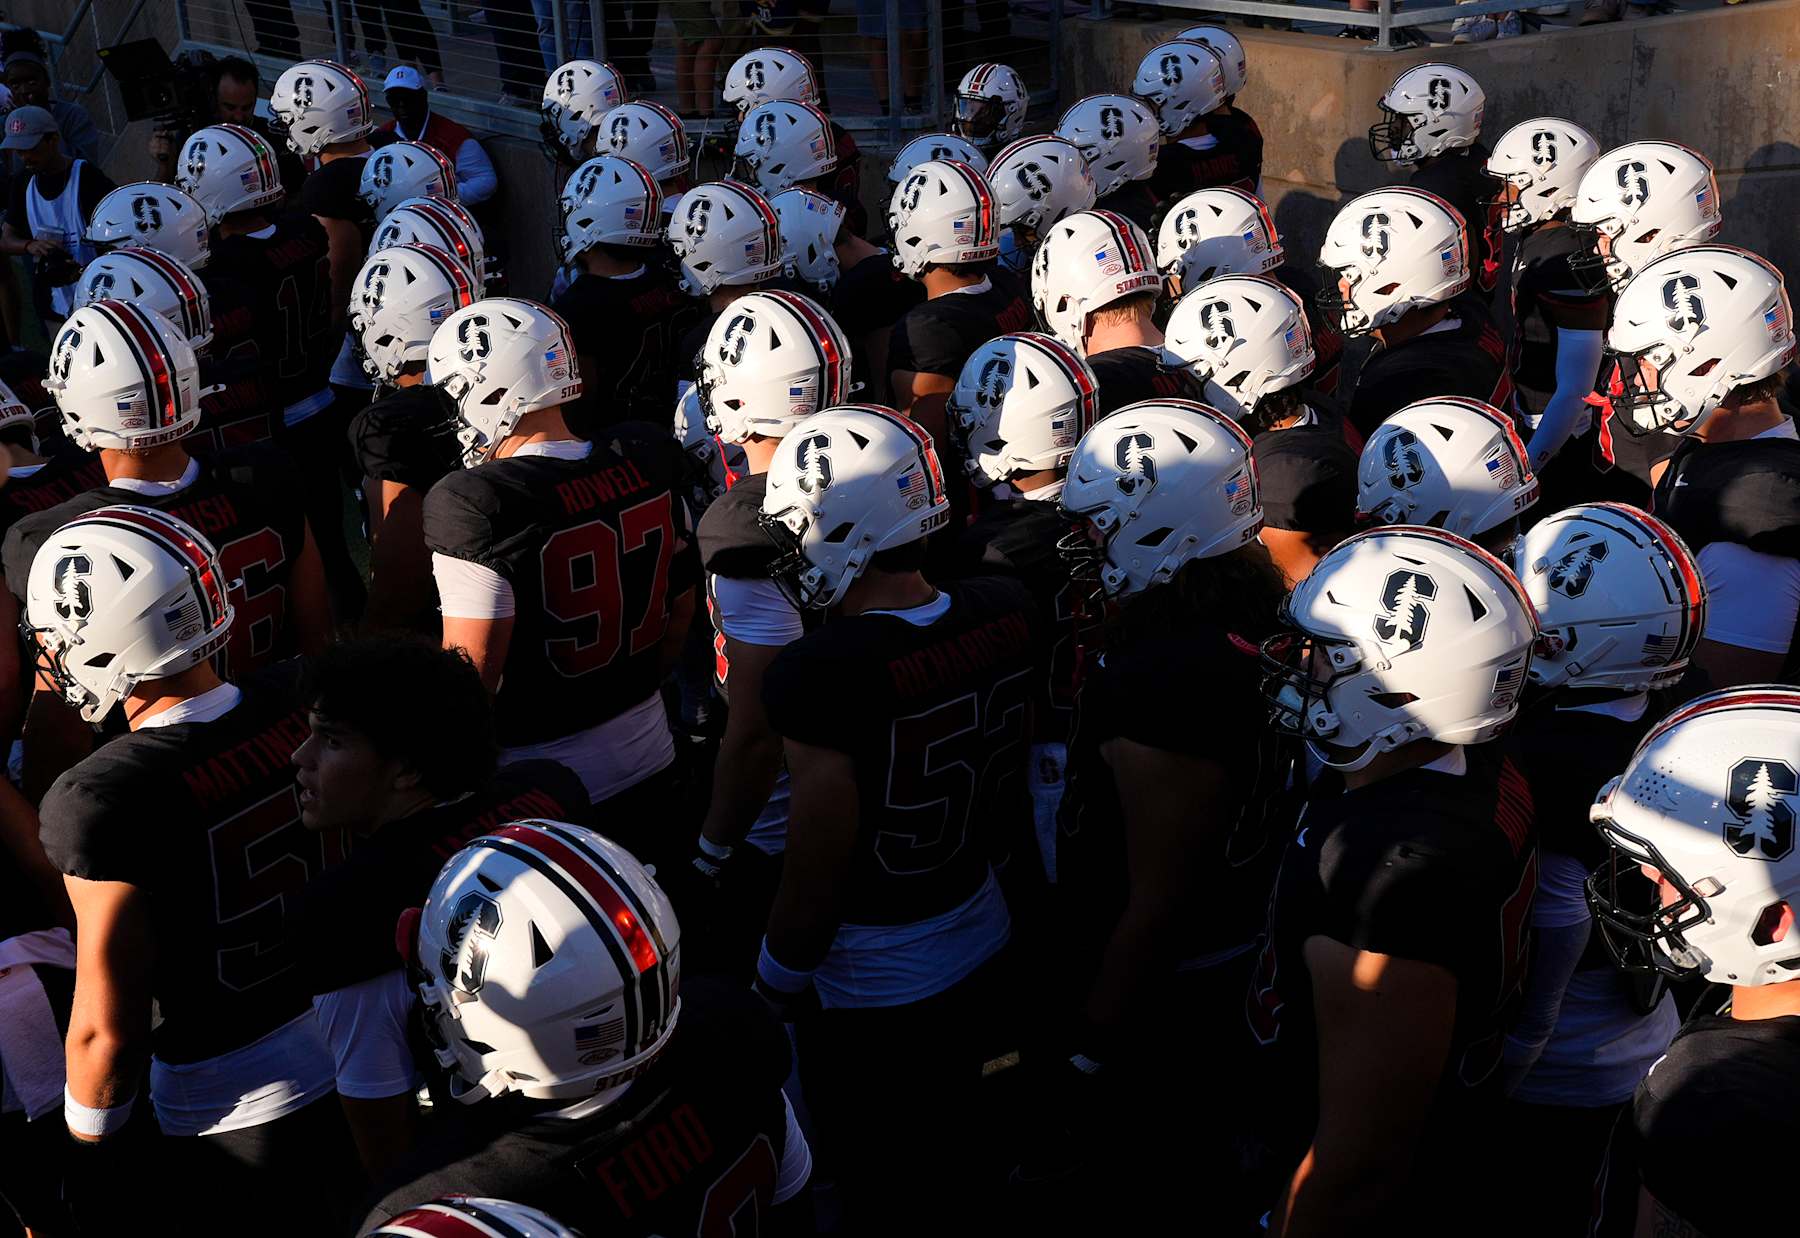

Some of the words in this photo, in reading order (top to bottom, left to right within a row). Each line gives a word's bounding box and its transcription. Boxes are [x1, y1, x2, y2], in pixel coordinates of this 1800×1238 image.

[294, 76, 313, 107] S
[557, 69, 575, 96] S
[745, 61, 765, 91] S
[1160, 54, 1184, 87] S
[1427, 78, 1451, 111] S
[610, 116, 629, 149] S
[756, 113, 776, 147] S
[1101, 107, 1125, 141] S
[187, 142, 208, 174] S
[1532, 131, 1557, 165] S
[373, 155, 393, 188] S
[575, 164, 604, 198] S
[900, 174, 927, 211] S
[1017, 163, 1052, 201] S
[1616, 160, 1650, 206] S
[131, 196, 163, 232] S
[686, 199, 712, 238] S
[1361, 212, 1392, 258] S
[363, 264, 392, 307] S
[1661, 273, 1706, 333] S
[458, 314, 492, 363] S
[719, 314, 756, 367] S
[1200, 299, 1237, 350] S
[976, 358, 1013, 409] S
[133, 421, 195, 447] STANFORD
[795, 431, 835, 495] S
[1114, 431, 1158, 498] S
[1384, 429, 1426, 491] S
[553, 457, 653, 519] ROWELL
[54, 554, 93, 621] S
[540, 488, 677, 678] 97
[1549, 537, 1609, 600] S
[216, 526, 287, 683] 6
[1372, 567, 1439, 650] S
[1723, 756, 1799, 862] S
[440, 889, 503, 995] S
[594, 1103, 716, 1220] FORD
